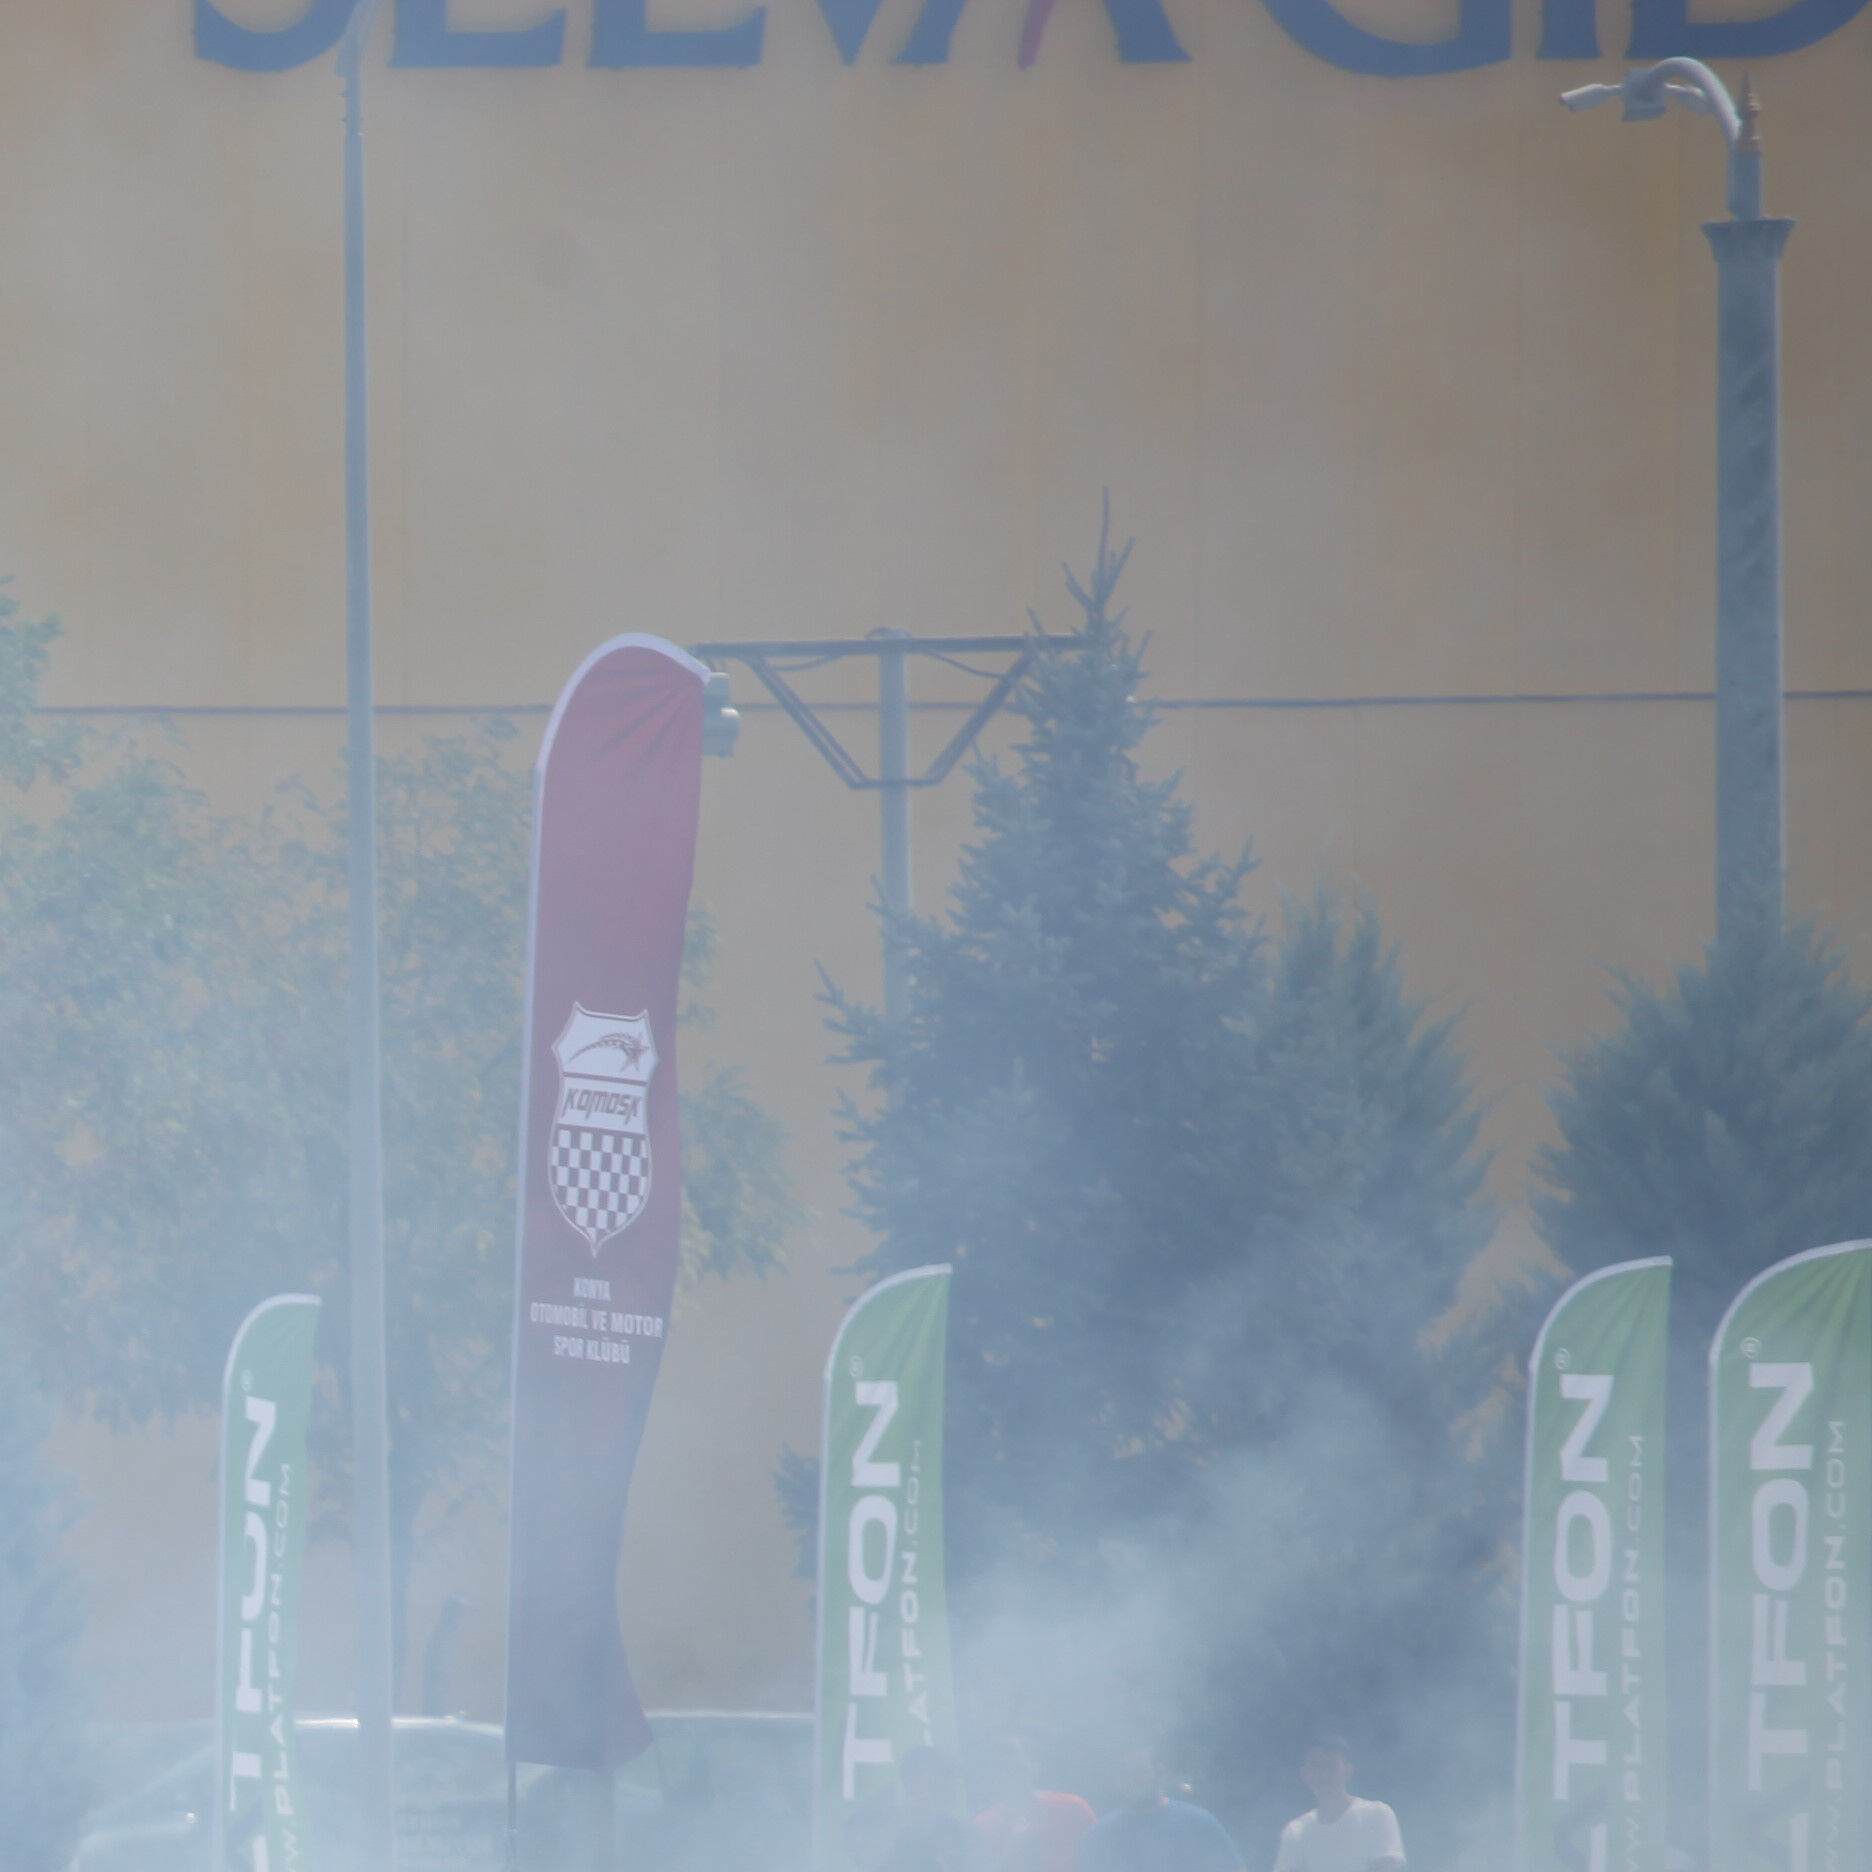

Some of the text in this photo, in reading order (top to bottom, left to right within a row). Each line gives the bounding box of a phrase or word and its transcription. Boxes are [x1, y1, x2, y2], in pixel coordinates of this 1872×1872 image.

[573, 1278, 611, 1301] KONYA
[592, 1310, 608, 1331] VE
[611, 1311, 663, 1338] MOTOR
[554, 1335, 584, 1359] SPOR
